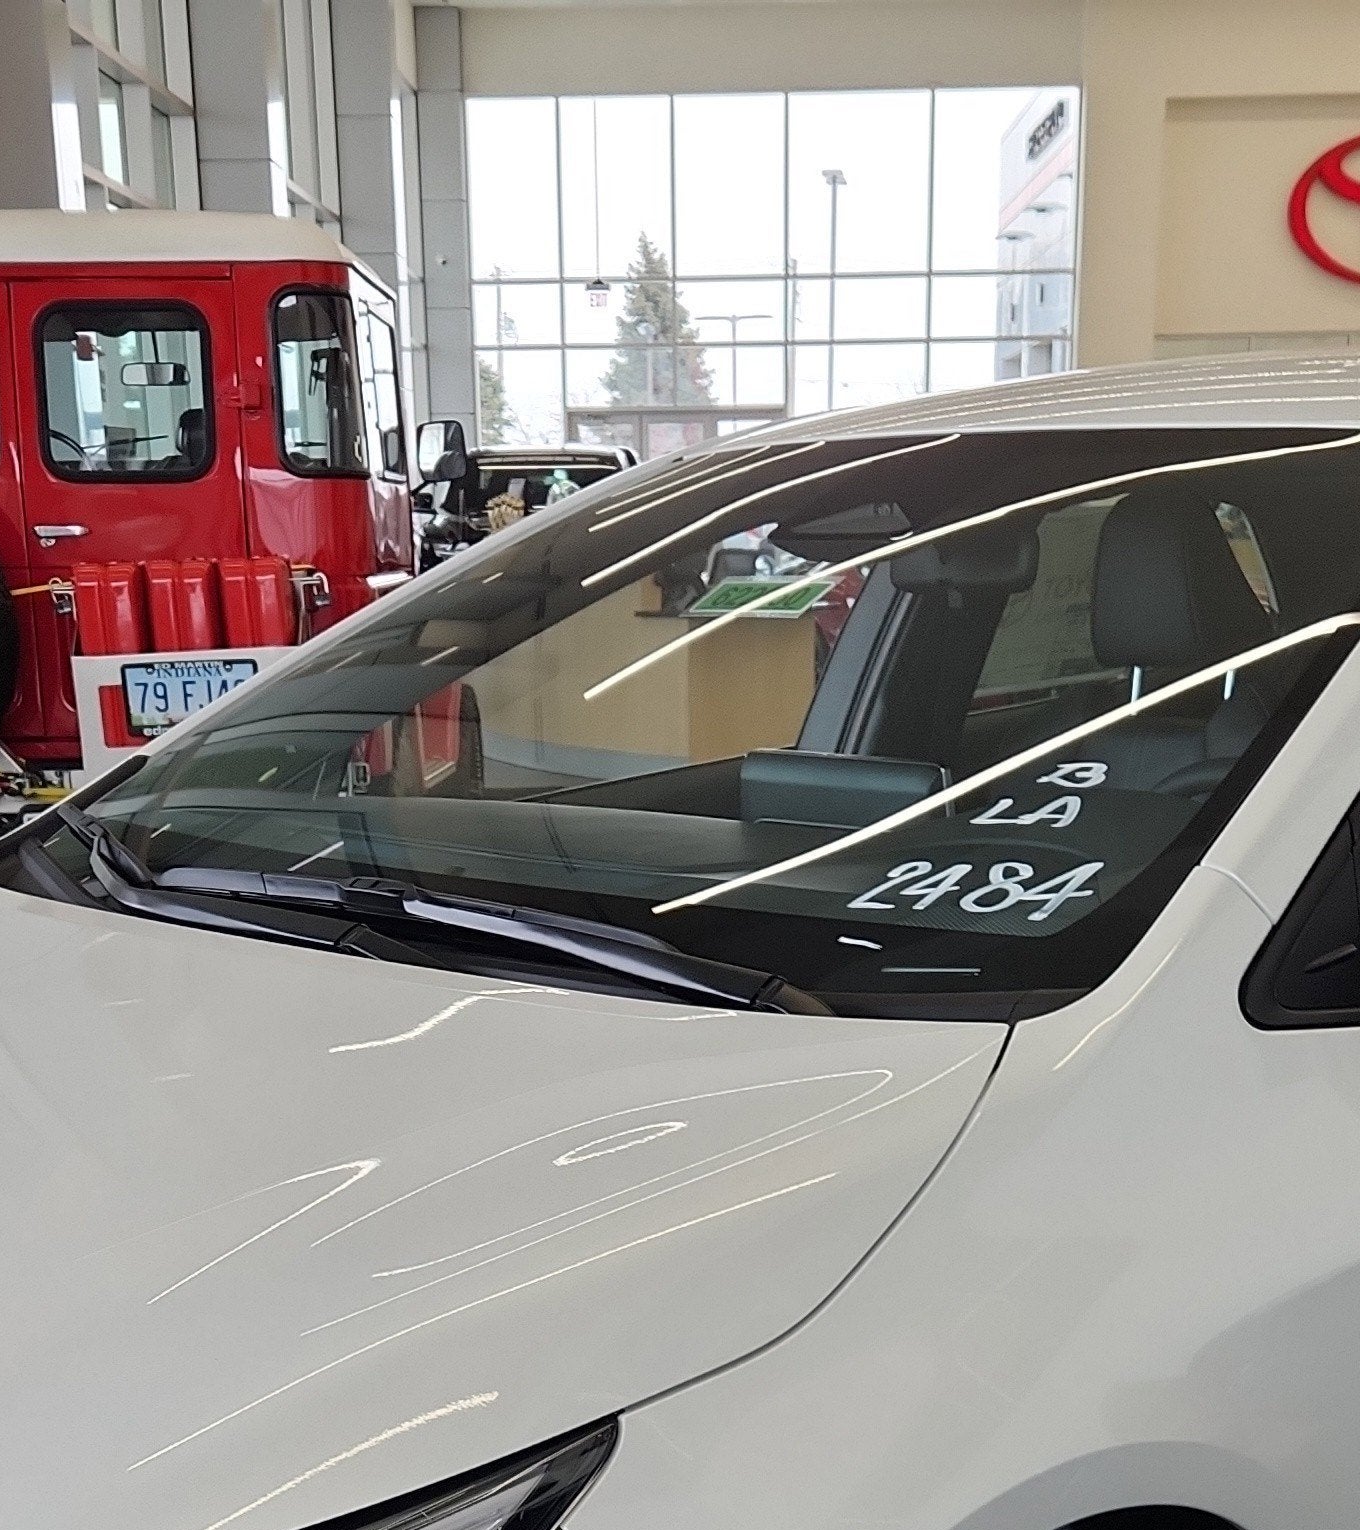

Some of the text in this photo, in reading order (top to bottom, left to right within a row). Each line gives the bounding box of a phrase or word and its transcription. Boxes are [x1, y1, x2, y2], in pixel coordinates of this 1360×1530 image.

[156, 667, 223, 679] INDIANA
[134, 681, 169, 714] 79
[969, 795, 1082, 828] LA
[846, 860, 1105, 922] 2484
